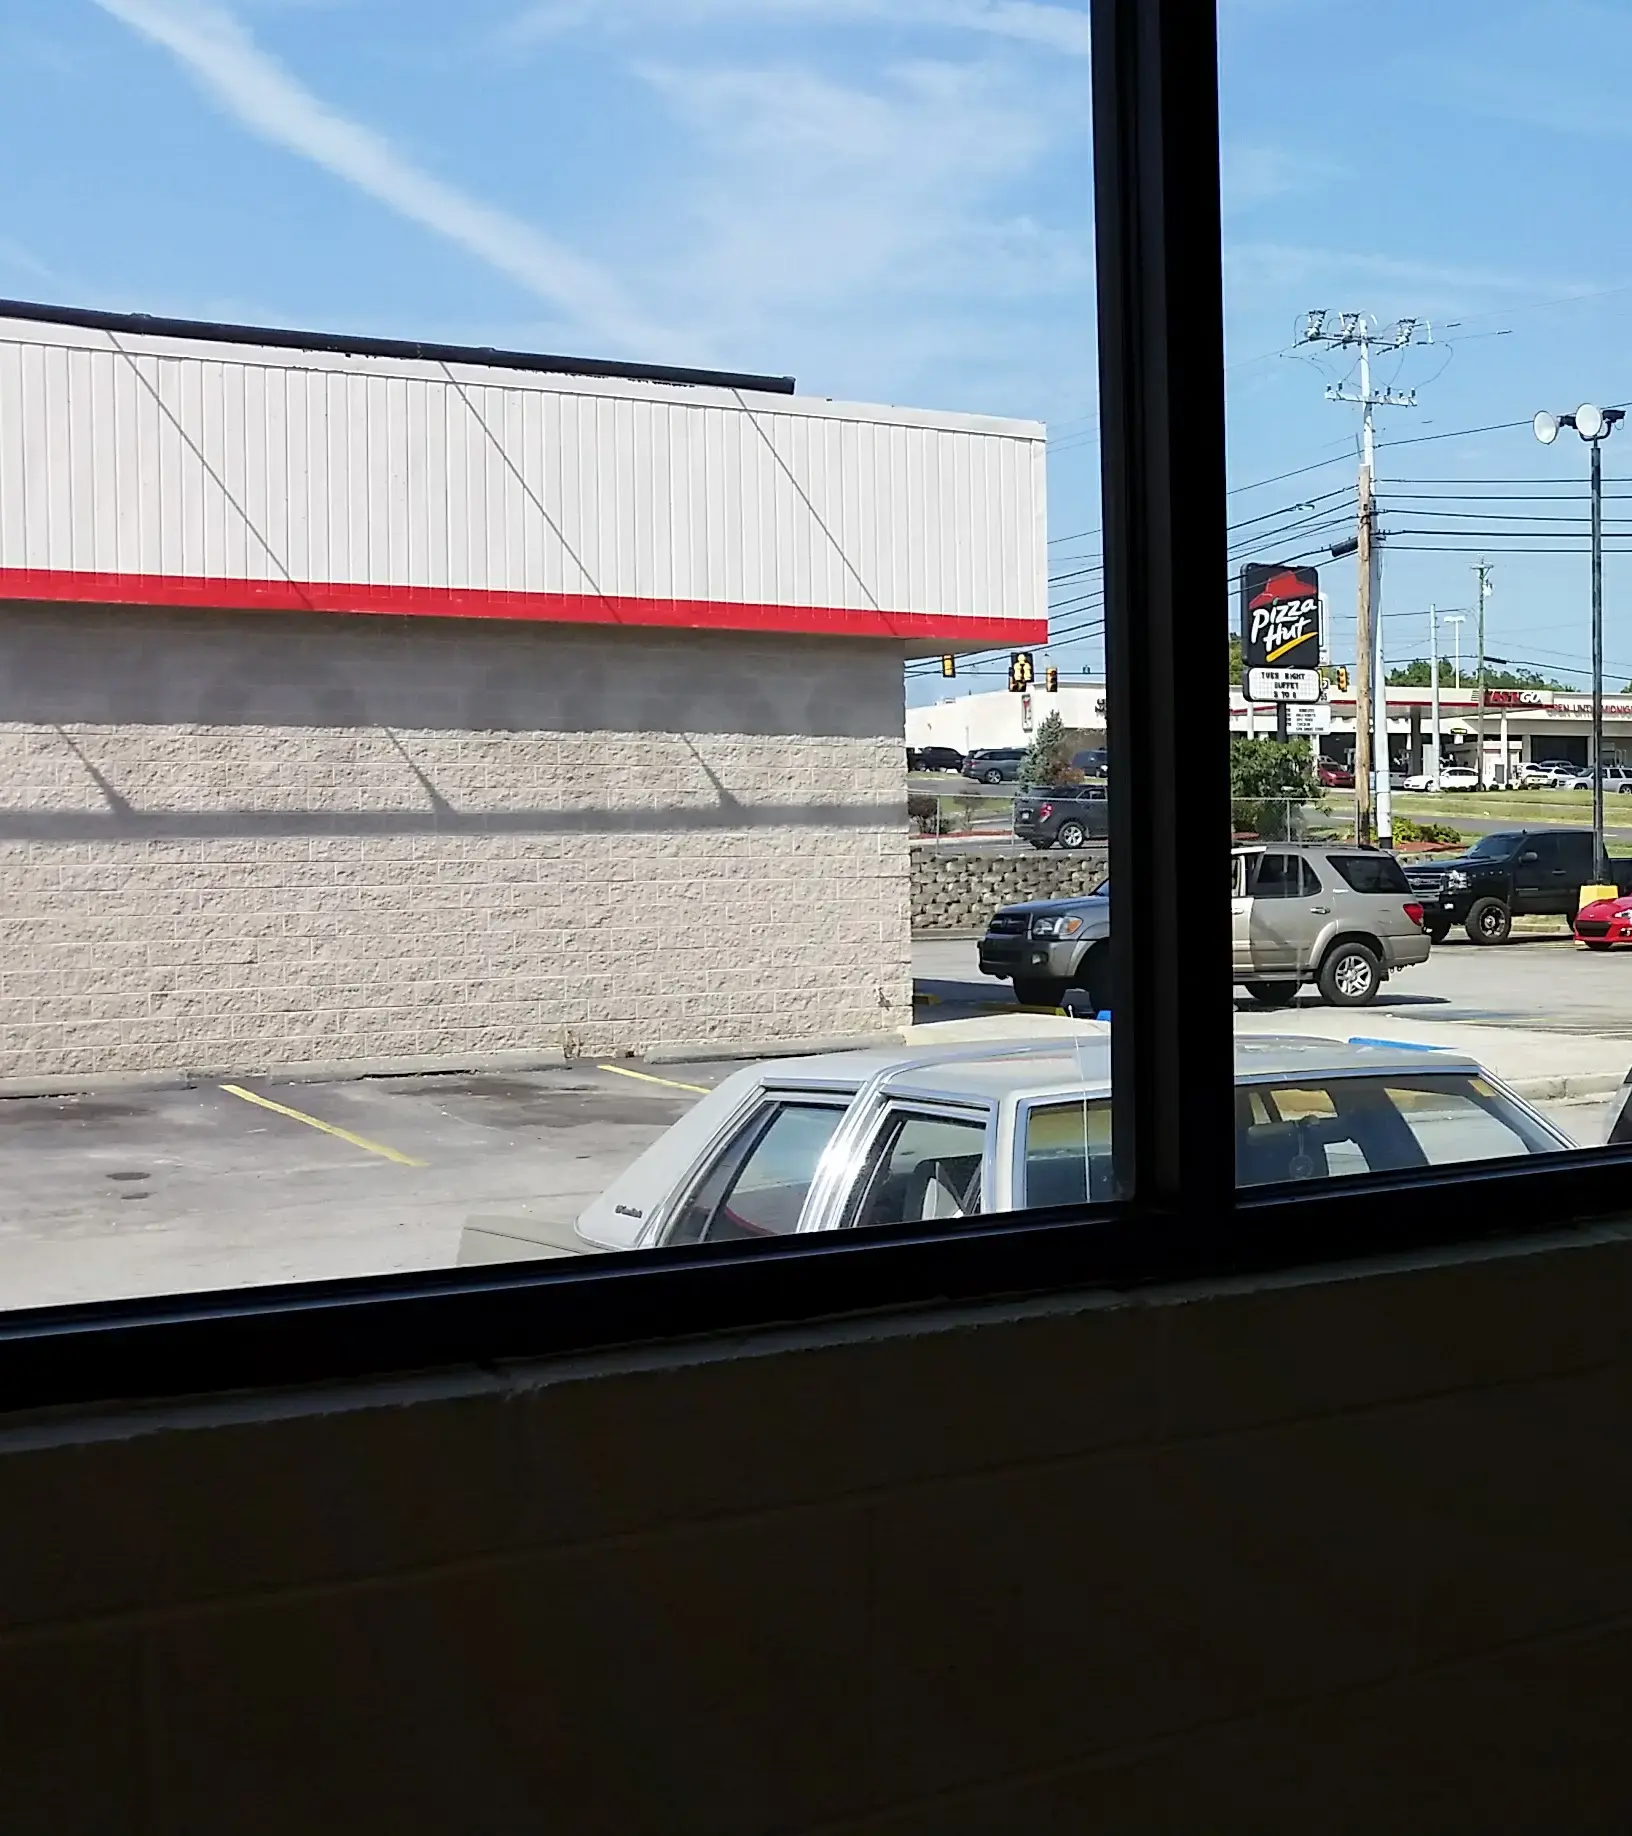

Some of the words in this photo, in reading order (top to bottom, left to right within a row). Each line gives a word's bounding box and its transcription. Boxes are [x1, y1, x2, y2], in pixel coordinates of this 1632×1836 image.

[1251, 598, 1318, 644] Pizza
[1263, 617, 1312, 652] Hut
[1274, 682, 1299, 690] BUFFET
[1281, 691, 1290, 699] TO
